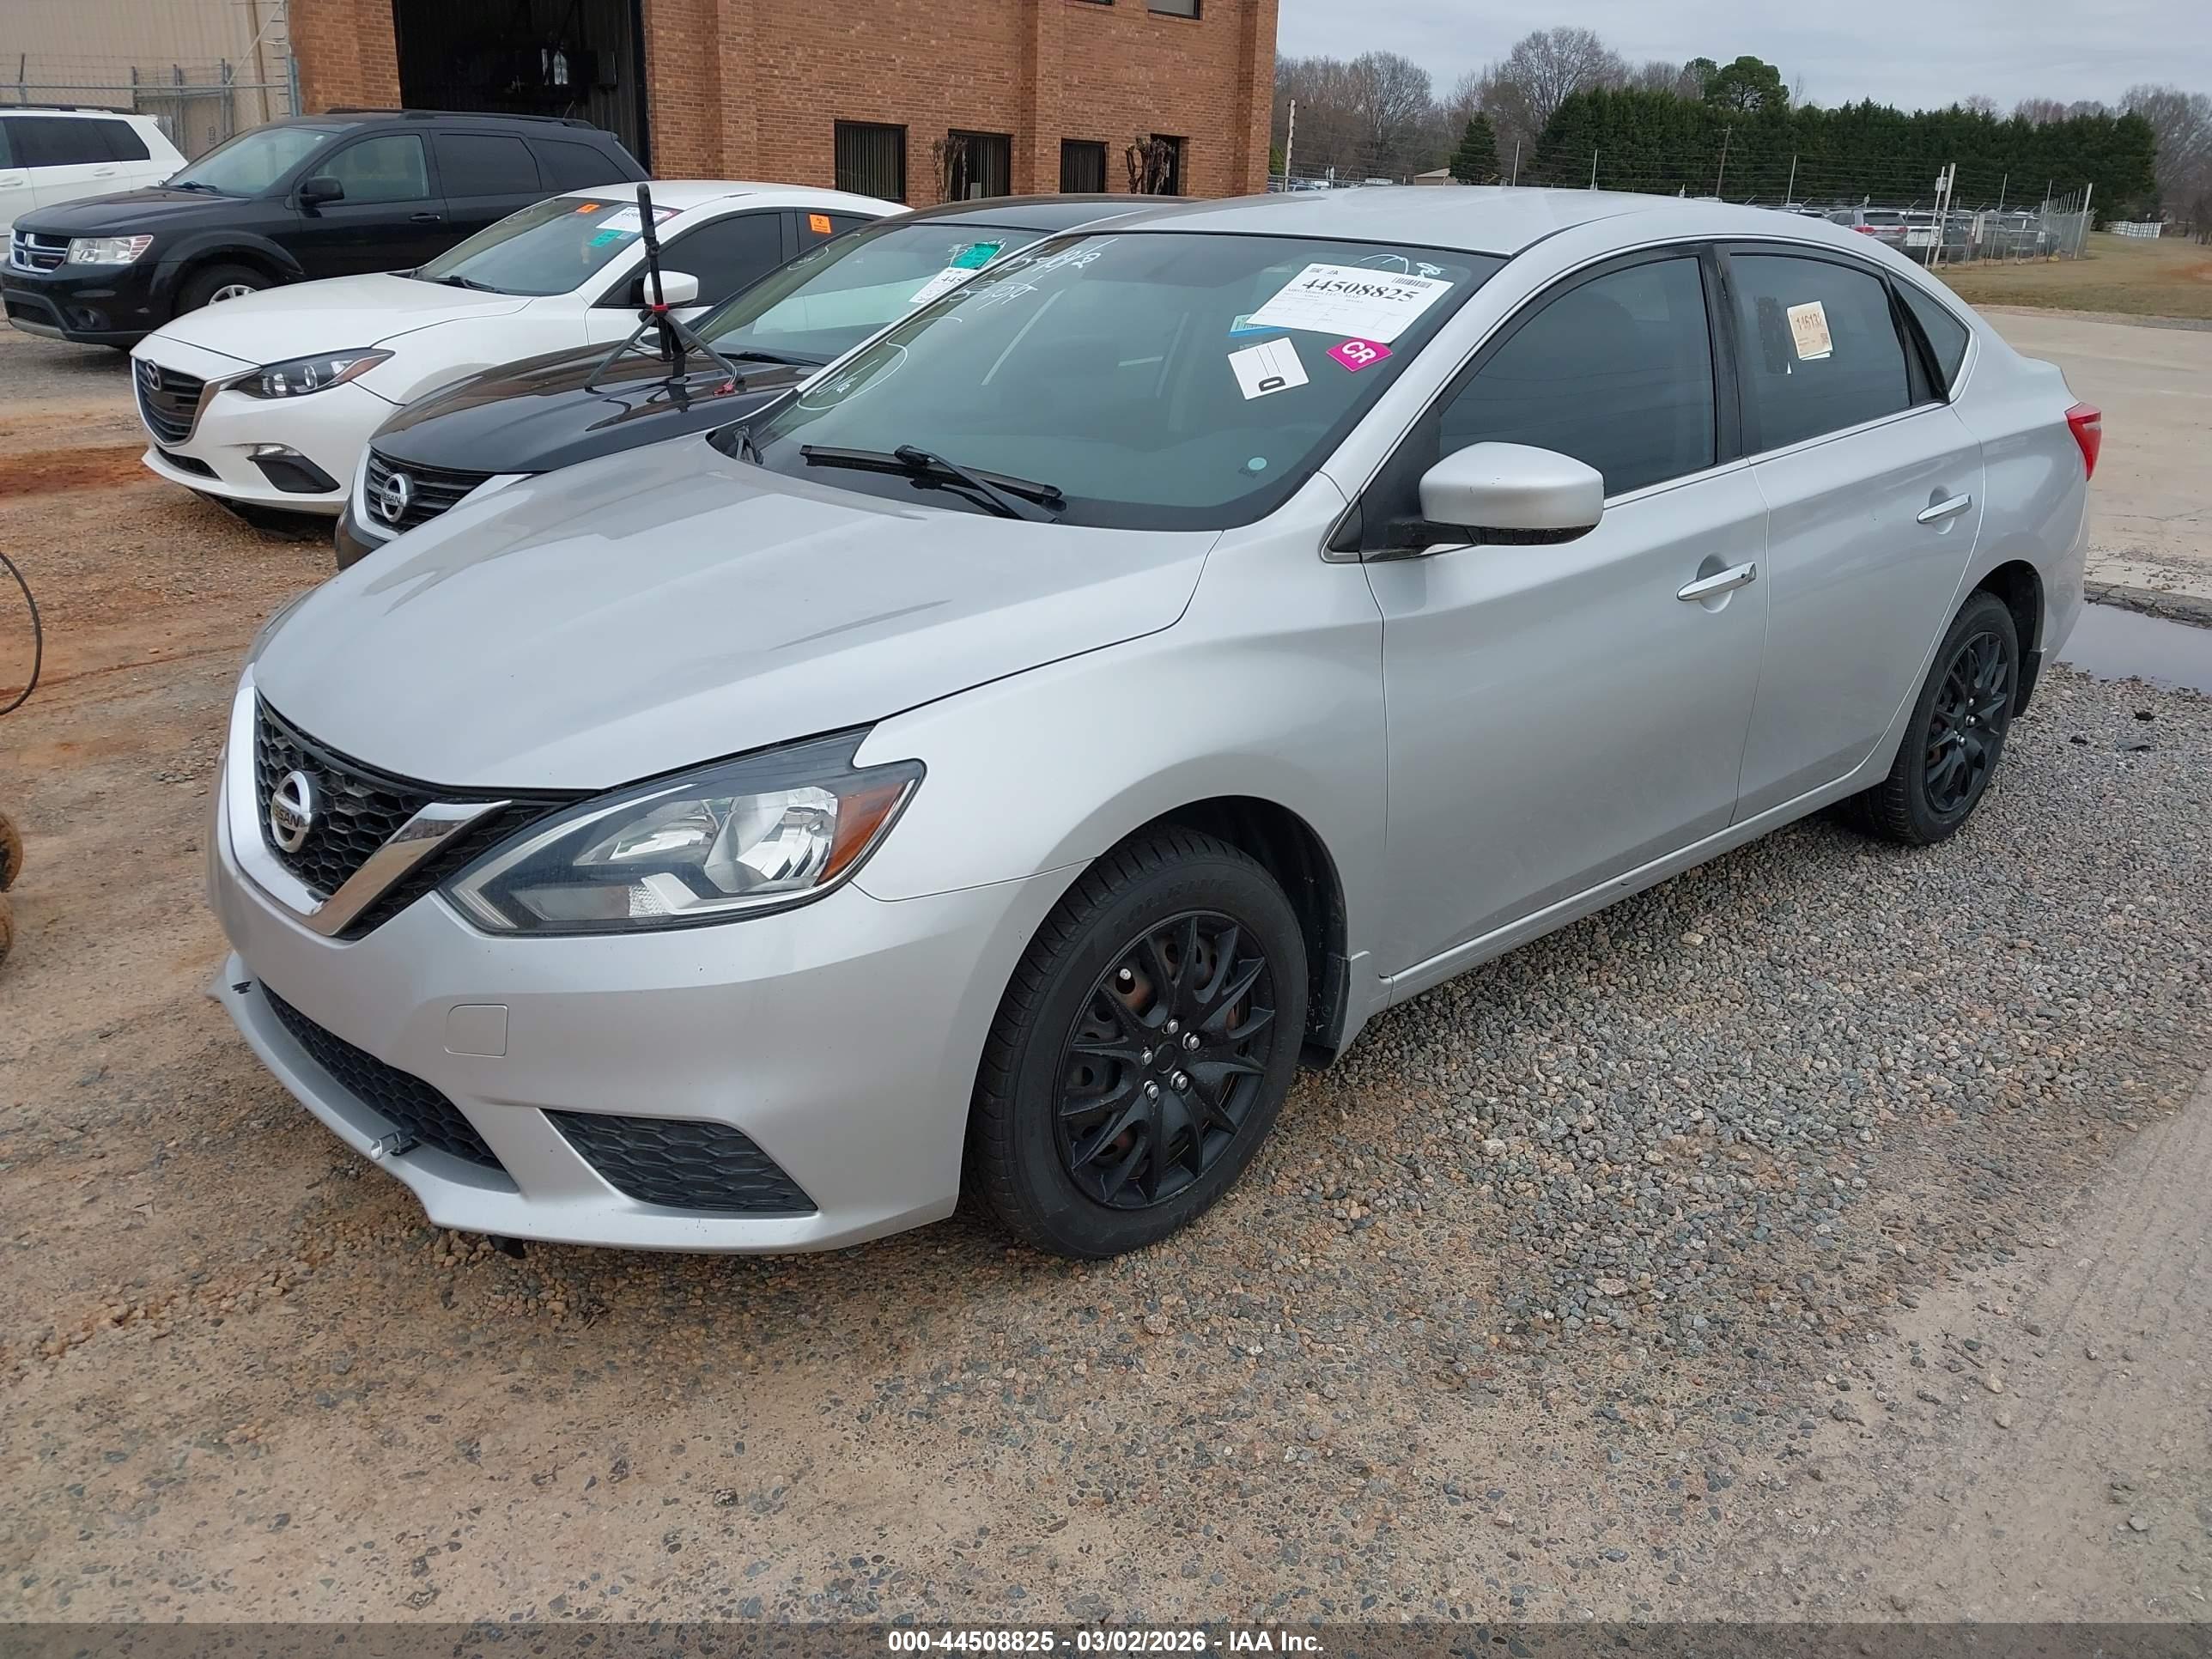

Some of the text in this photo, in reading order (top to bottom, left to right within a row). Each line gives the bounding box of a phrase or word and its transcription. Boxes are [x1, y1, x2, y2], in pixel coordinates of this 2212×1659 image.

[1302, 278, 1419, 302] 44508825
[1341, 341, 1377, 364] CR
[1257, 375, 1286, 392] D
